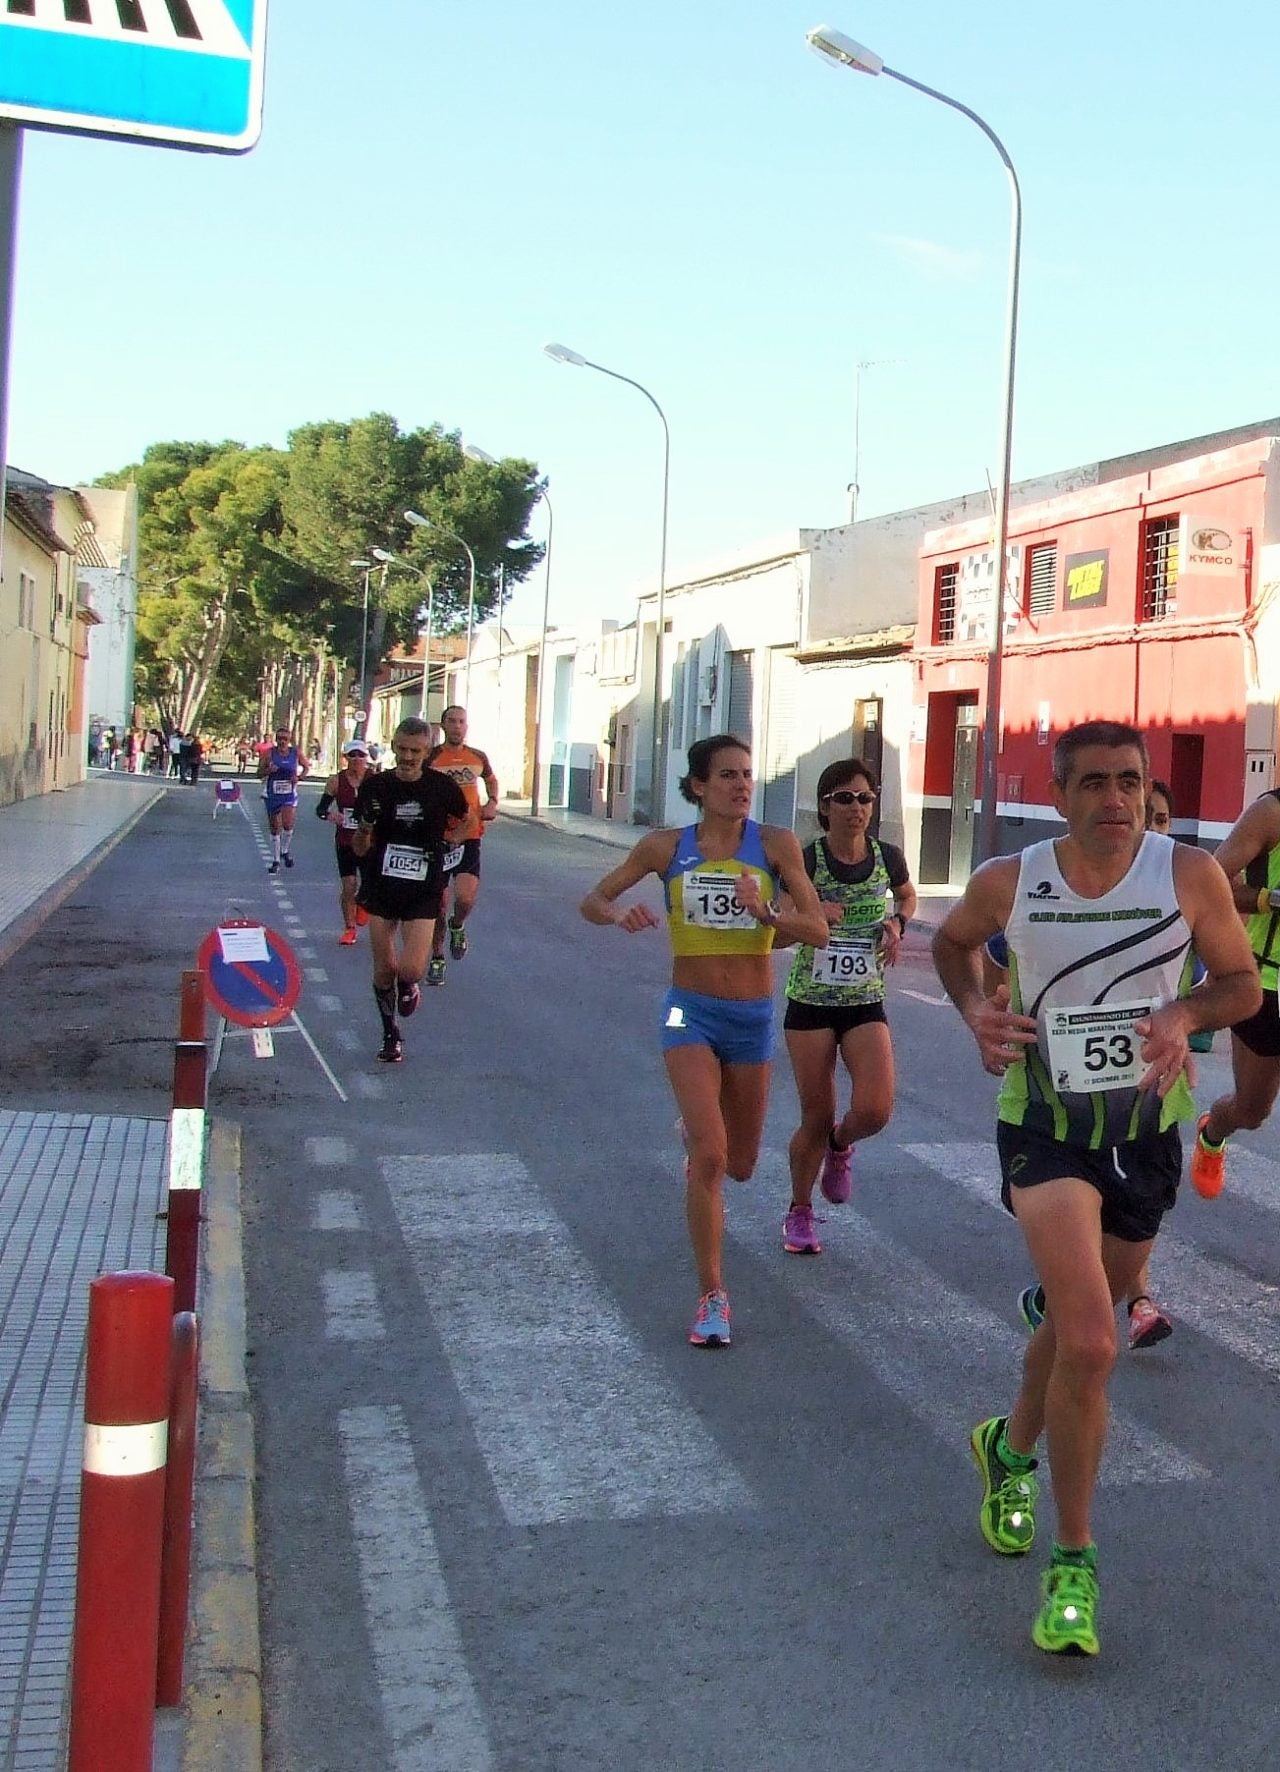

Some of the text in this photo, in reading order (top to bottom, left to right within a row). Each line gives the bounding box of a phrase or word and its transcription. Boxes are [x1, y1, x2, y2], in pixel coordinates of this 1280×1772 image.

[1189, 554, 1233, 565] KYMCO
[391, 856, 421, 873] 1054
[698, 893, 747, 916] 139
[828, 954, 868, 975] 193
[1084, 1034, 1133, 1071] 53
